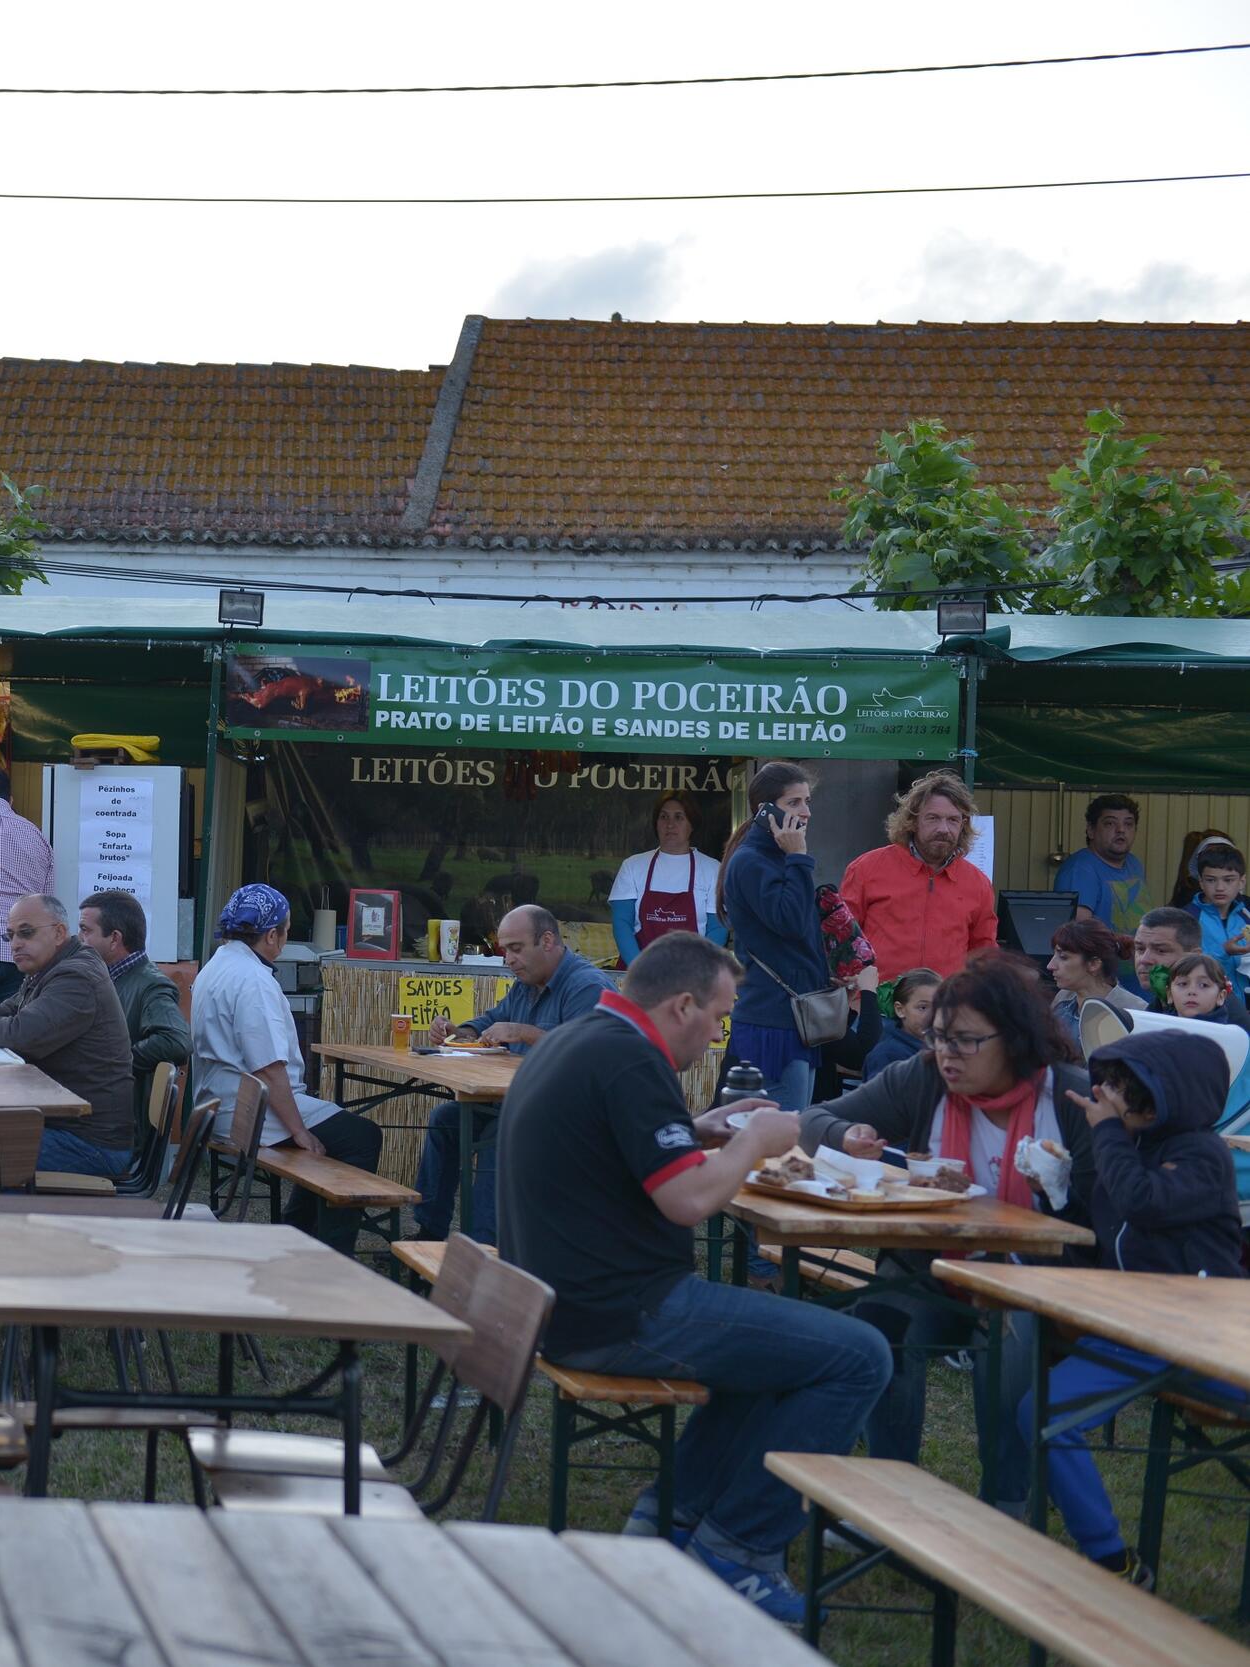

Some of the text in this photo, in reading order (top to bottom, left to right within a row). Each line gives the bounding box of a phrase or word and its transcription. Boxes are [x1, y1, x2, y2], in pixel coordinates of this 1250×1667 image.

[377, 668, 848, 716] LEITÕES DO POCEIRÃO
[375, 710, 847, 742] PRATO DE LEITÃO E SANDES DE LEITÃO
[351, 752, 496, 787] LEITÕES
[98, 785, 136, 793] Pézinhos
[95, 810, 137, 818] coentrada
[105, 830, 127, 839] Sopa
[97, 873, 133, 882] Feijoada
[426, 998, 438, 1006] DE
